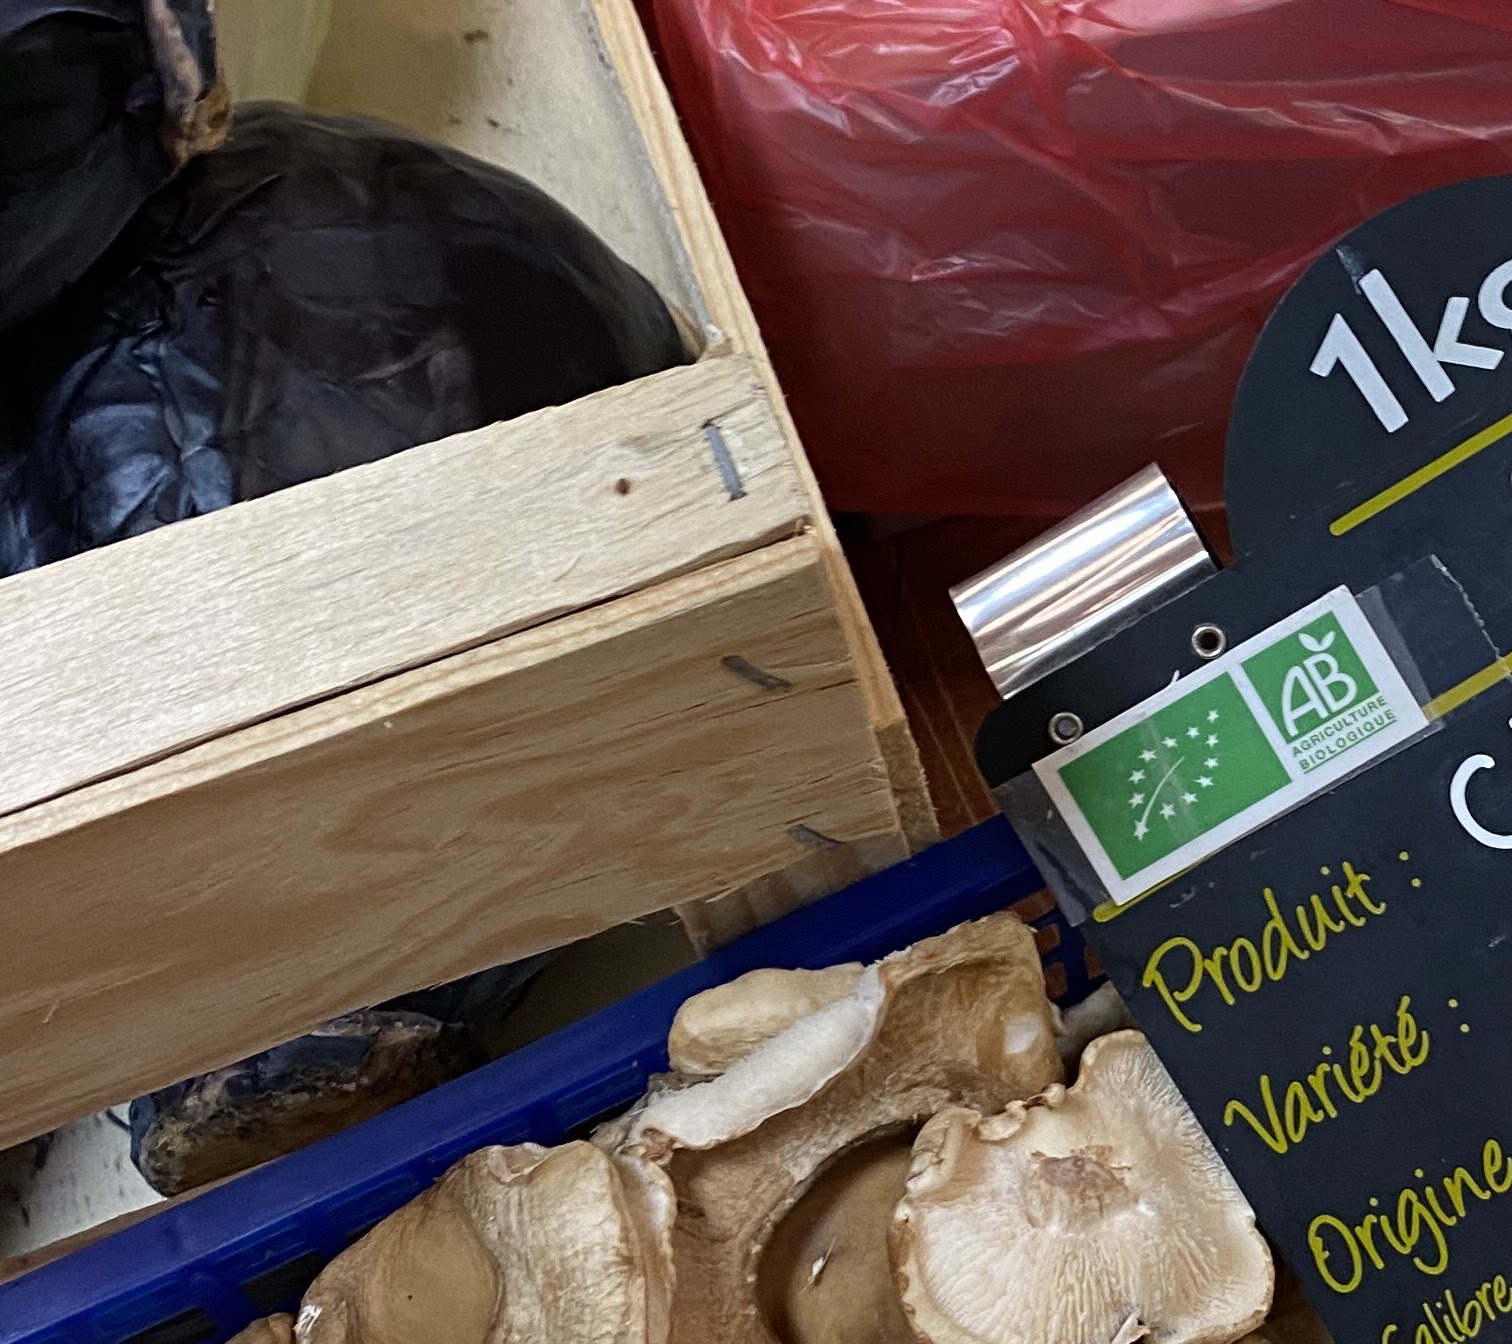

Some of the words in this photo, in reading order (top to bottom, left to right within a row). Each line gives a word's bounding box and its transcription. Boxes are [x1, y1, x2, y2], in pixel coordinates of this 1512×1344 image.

[1280, 651, 1358, 738] AB
[1291, 694, 1388, 759] AGRICULTURE
[1298, 708, 1397, 771] BIOLOGIQUE
[1142, 864, 1388, 1033] Produit
[1223, 995, 1430, 1157] Variété
